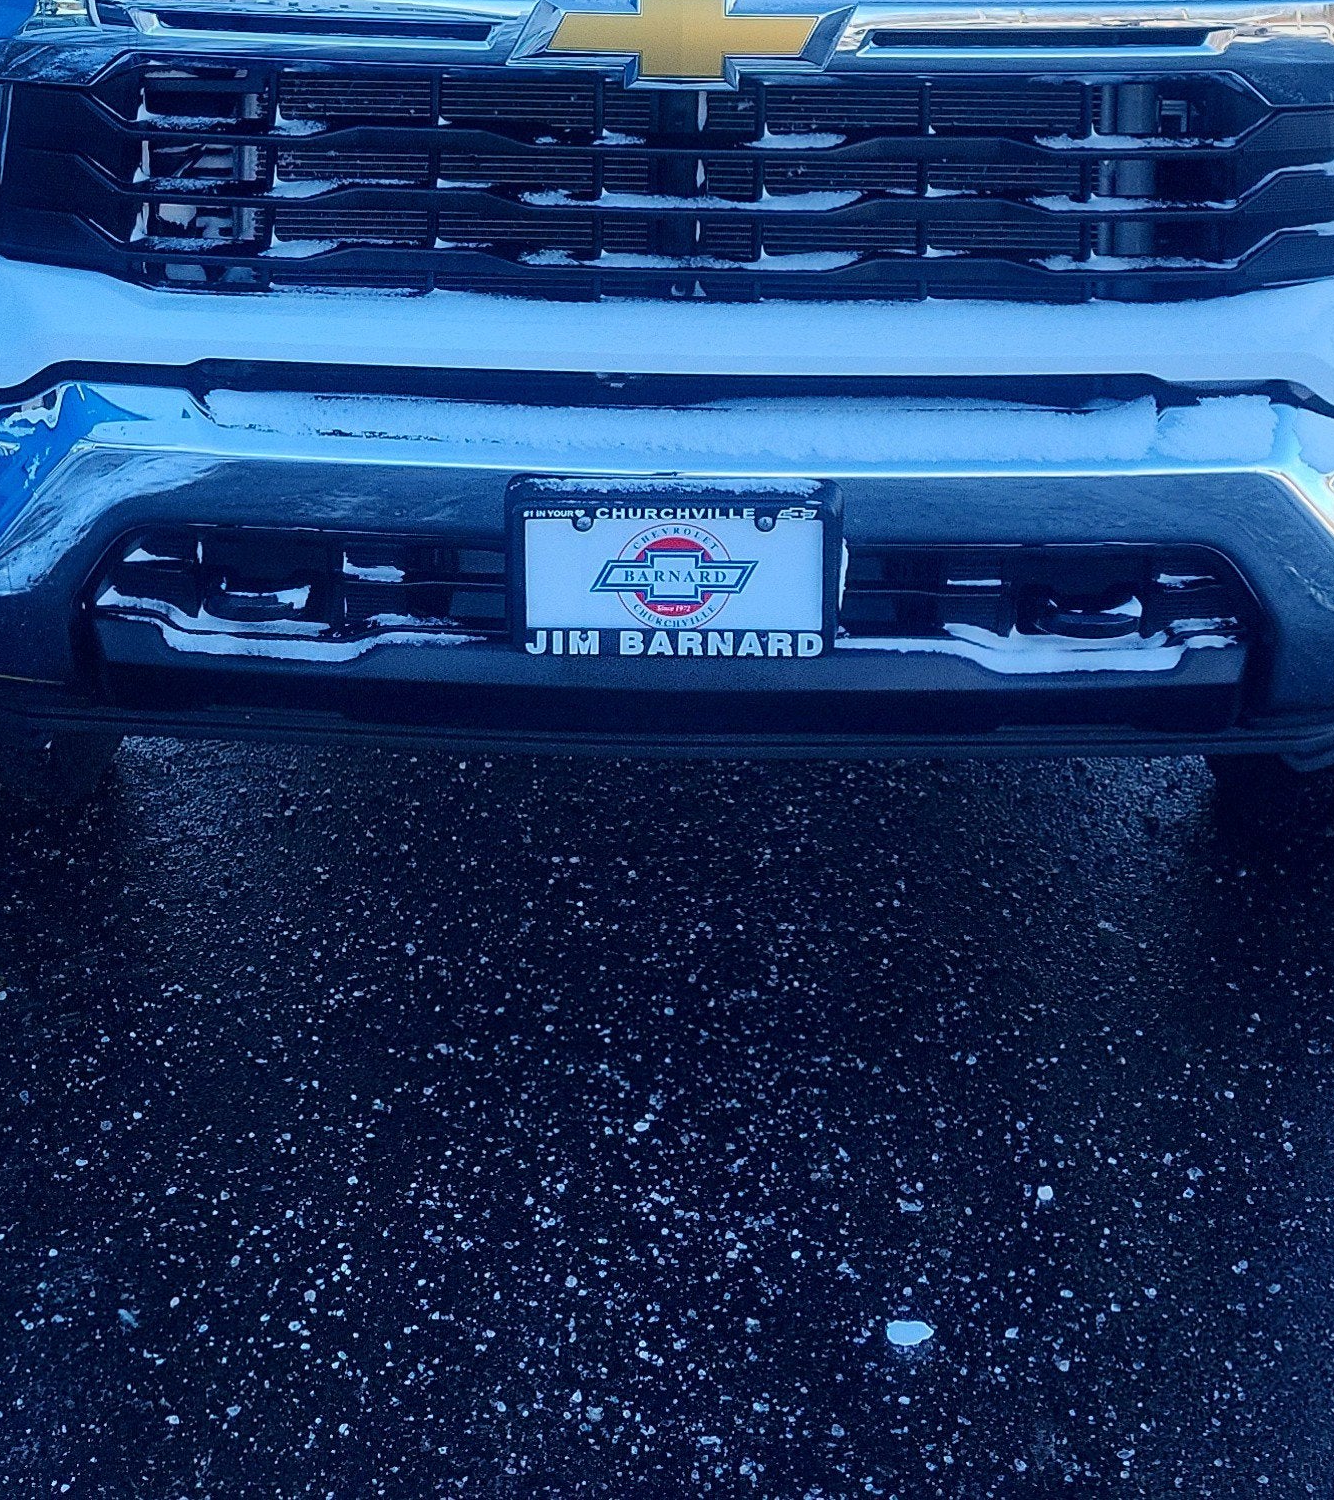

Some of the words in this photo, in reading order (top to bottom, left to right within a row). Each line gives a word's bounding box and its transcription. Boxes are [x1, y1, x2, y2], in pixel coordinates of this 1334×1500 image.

[536, 510, 546, 518] IN
[547, 510, 574, 518] YOUR
[595, 508, 756, 520] CHURCHVILLE
[633, 527, 719, 550] CHEVROLET
[623, 569, 727, 584] BARNARD
[633, 604, 715, 627] CHURCHVILLE
[657, 604, 675, 612] Since
[525, 630, 600, 656] JIM
[619, 630, 824, 658] BARNARD
